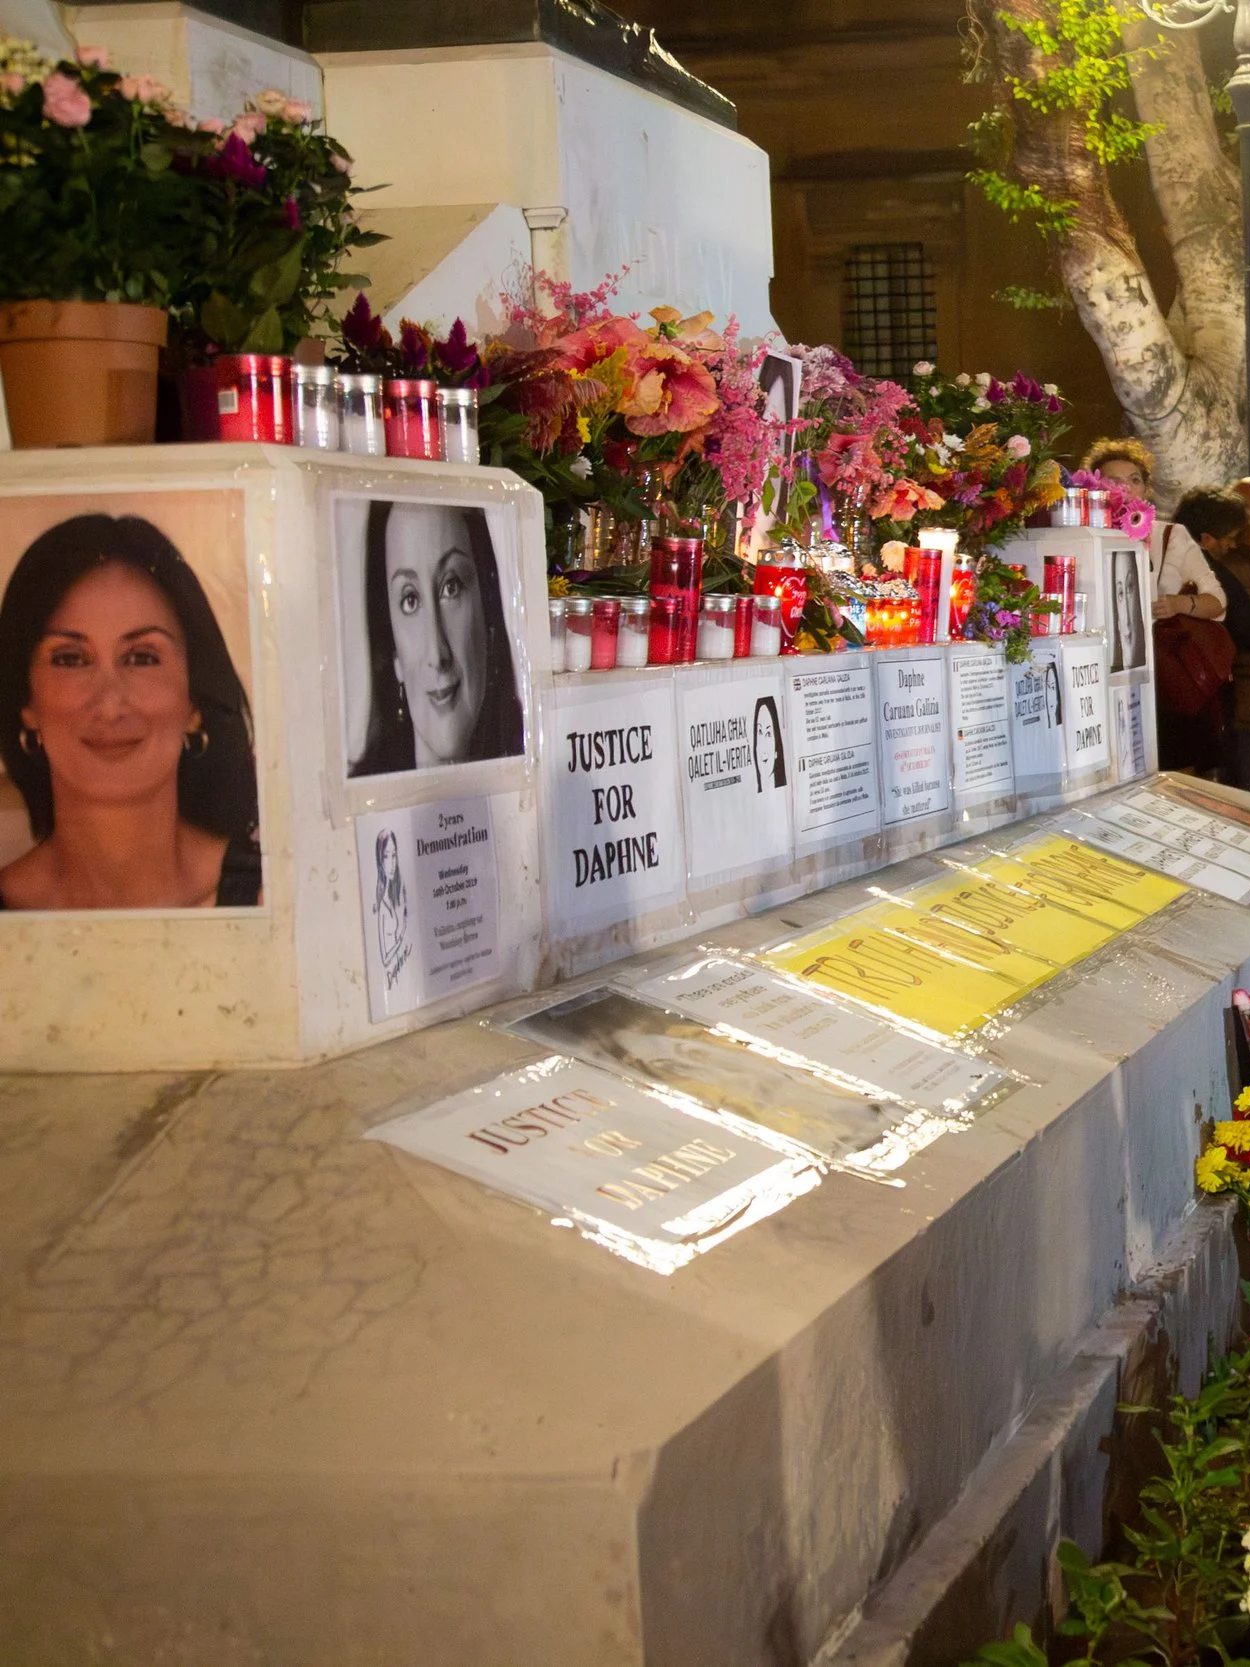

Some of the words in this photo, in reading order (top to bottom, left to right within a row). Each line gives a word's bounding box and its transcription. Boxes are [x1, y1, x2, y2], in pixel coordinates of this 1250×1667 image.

[898, 668, 925, 693] Daphne
[1072, 663, 1099, 688] JUSTICE
[883, 701, 915, 721] Caruana
[916, 697, 939, 717] Galizia
[1080, 696, 1094, 718] FOR
[566, 725, 653, 773] JUSTICE
[690, 720, 727, 751] QATLUHA
[688, 752, 714, 783] QALET
[592, 784, 636, 825] FOR
[438, 813, 443, 828] 2
[444, 814, 464, 831] years
[416, 826, 488, 857] Demonstration
[572, 832, 660, 888] DAPHNE
[800, 931, 957, 1001] TRUTH
[467, 1088, 618, 1154] JUSTICE
[596, 1138, 737, 1211] DAPHNE
